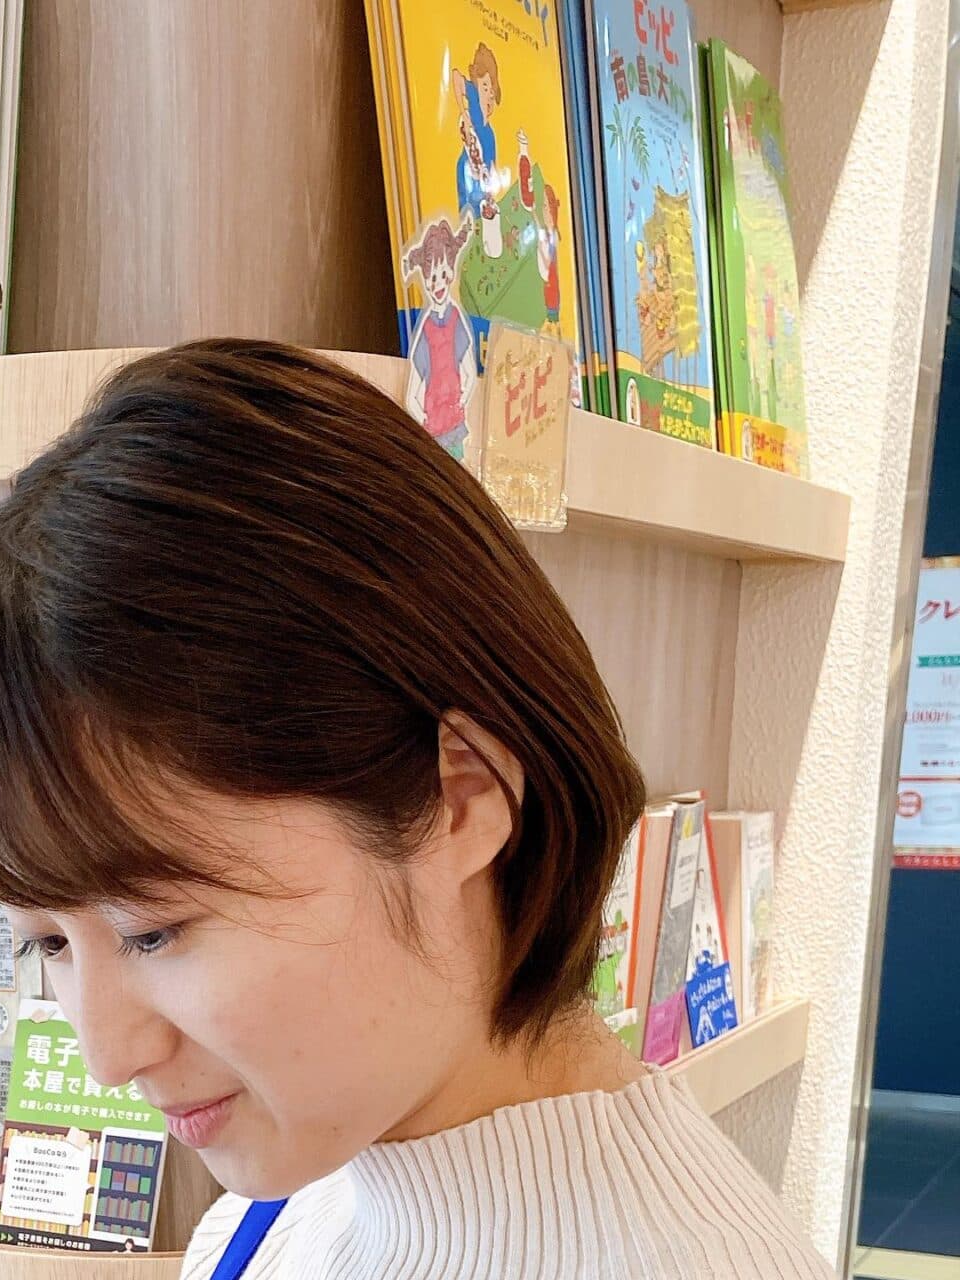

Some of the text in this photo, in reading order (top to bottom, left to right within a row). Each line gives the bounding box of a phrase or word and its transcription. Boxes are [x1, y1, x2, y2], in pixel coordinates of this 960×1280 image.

[19, 1099, 152, 1123] お探しの本が電子で購入できます
